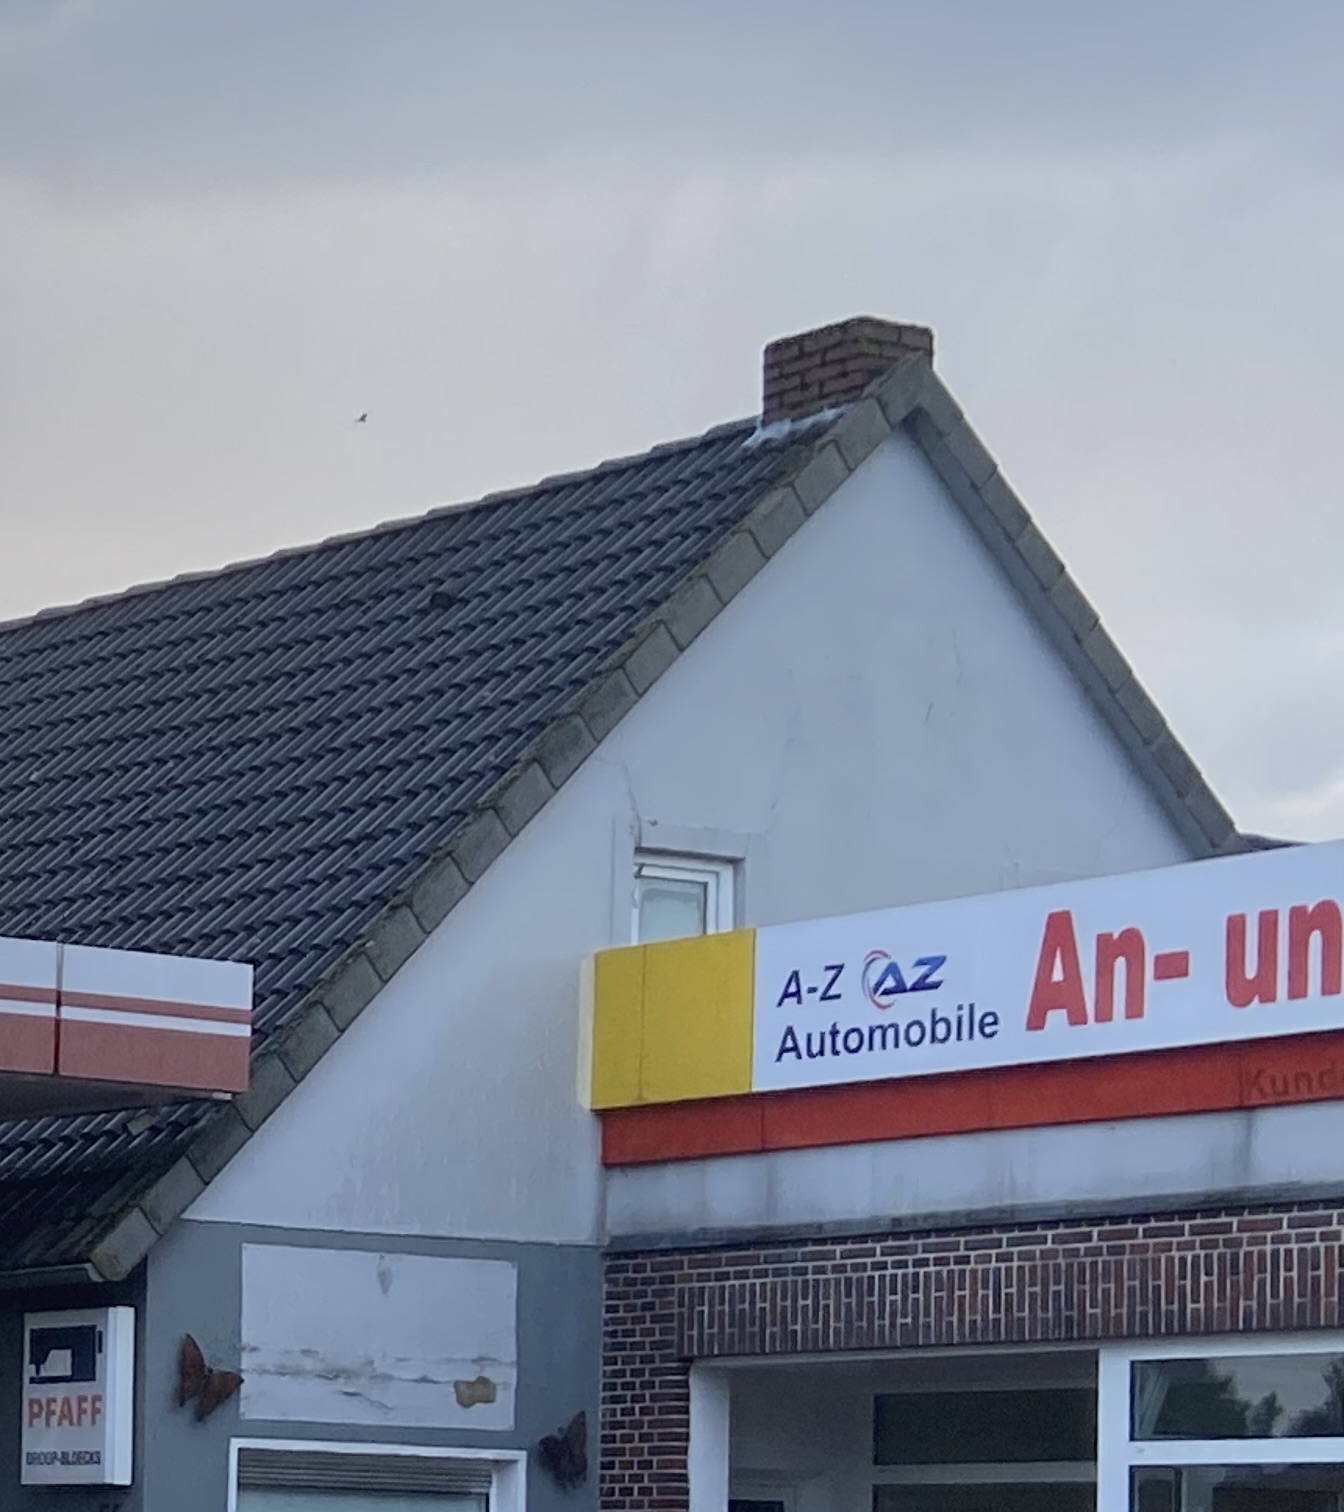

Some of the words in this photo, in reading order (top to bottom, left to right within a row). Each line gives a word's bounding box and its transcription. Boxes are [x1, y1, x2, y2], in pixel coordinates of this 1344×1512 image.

[776, 963, 845, 1008] A-Z
[1024, 909, 1189, 1032] An-
[775, 1003, 1000, 1063] Automobile
[1248, 1060, 1344, 1098] Kund
[28, 1395, 103, 1429] PFAFF
